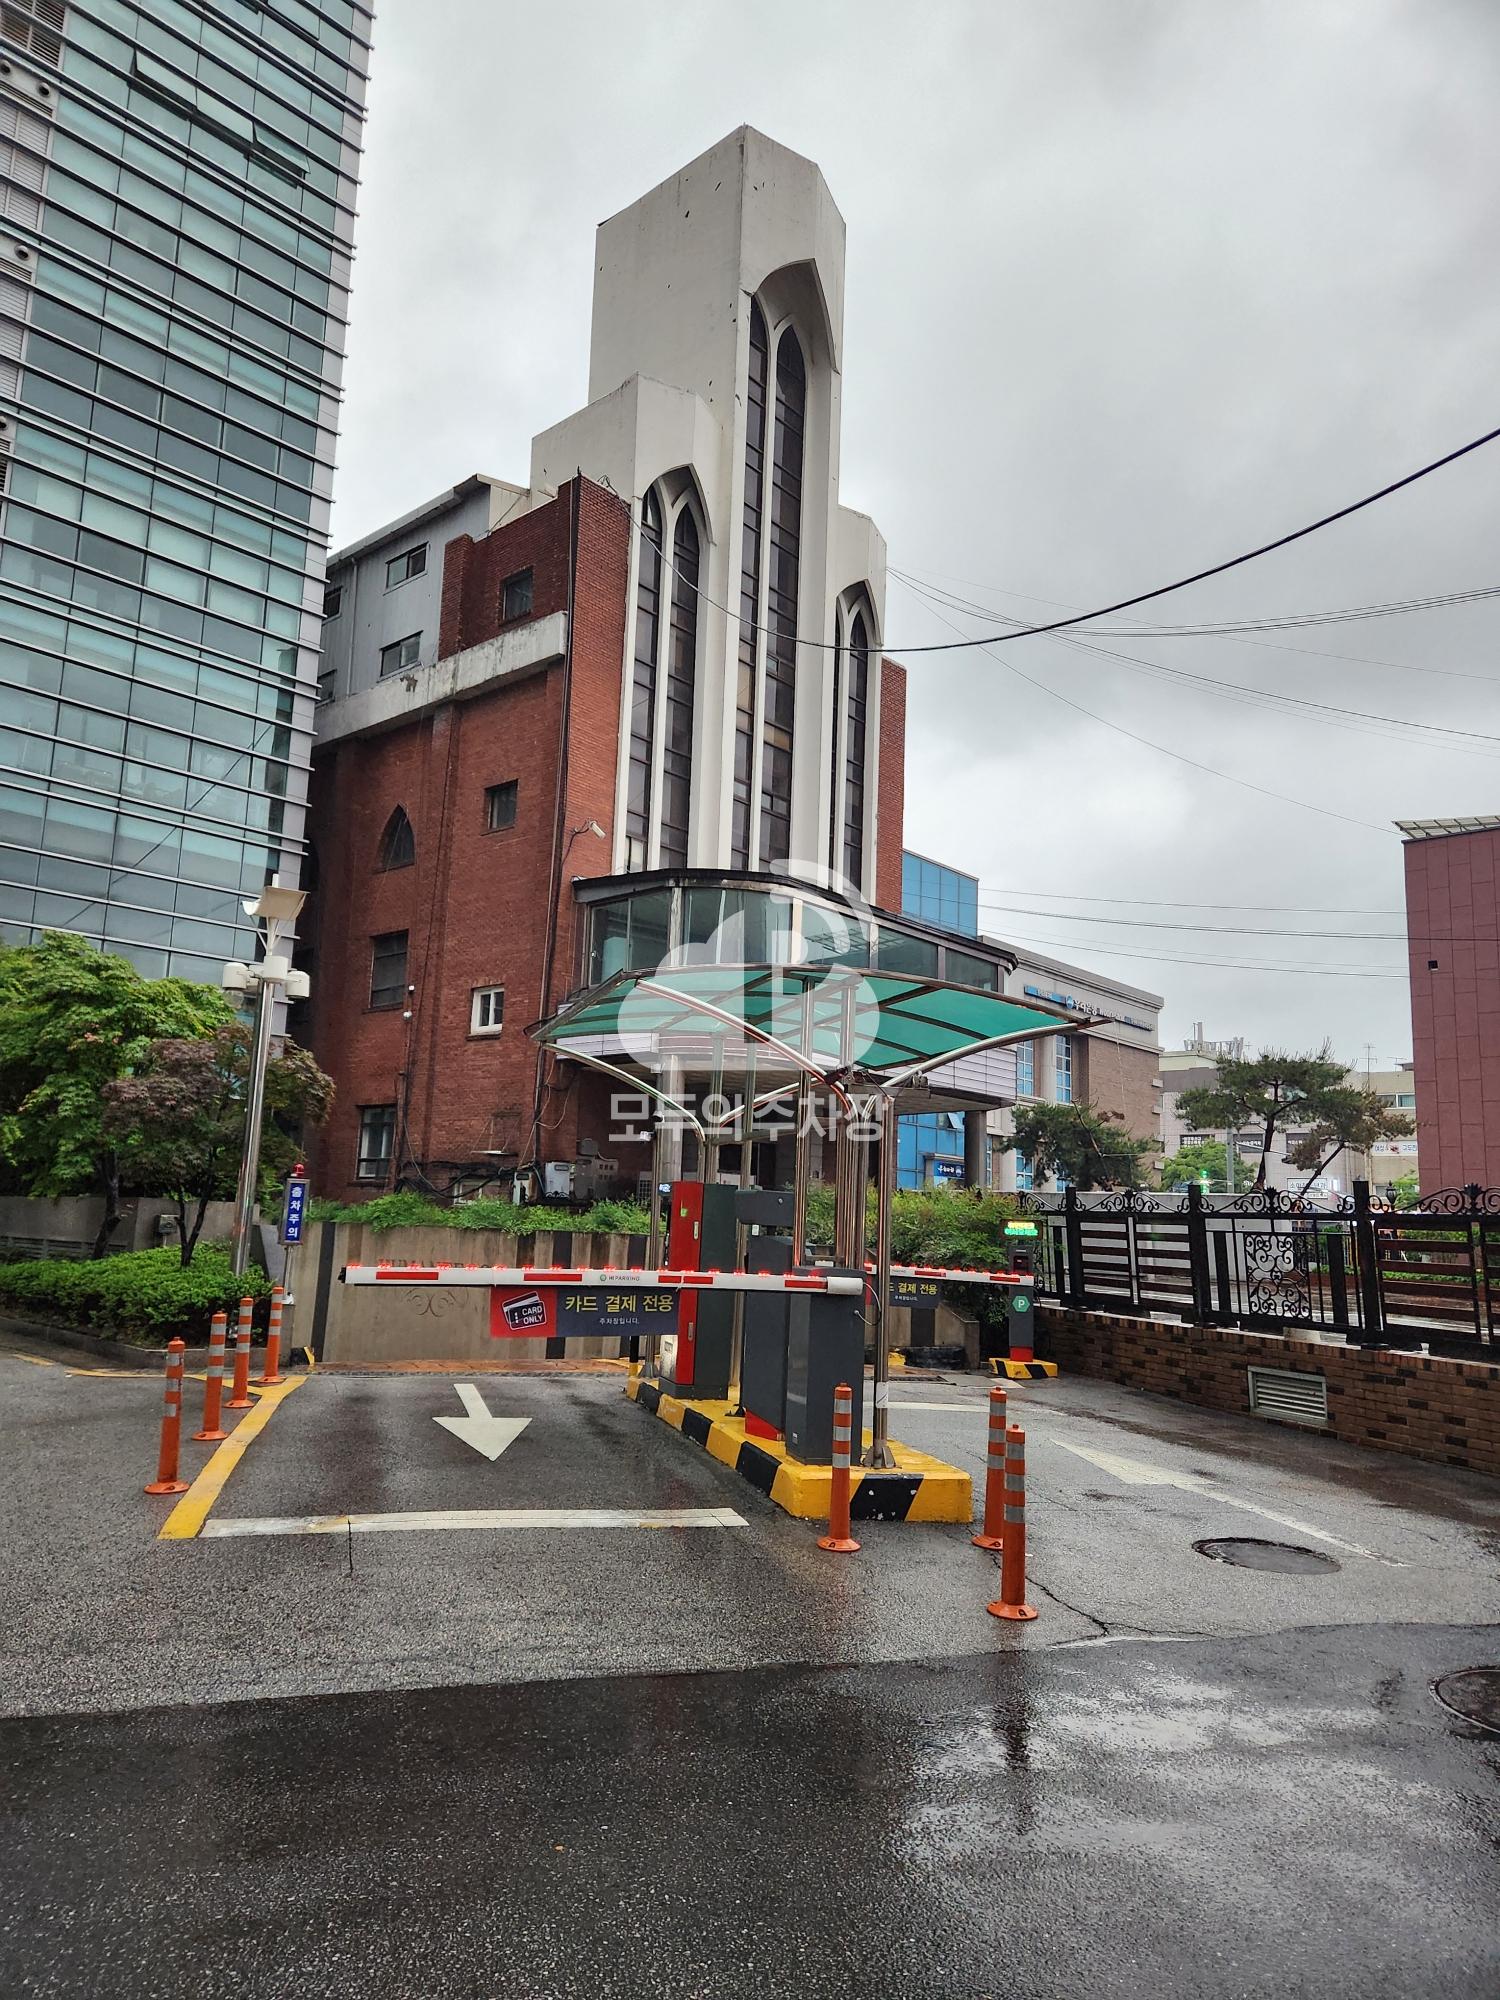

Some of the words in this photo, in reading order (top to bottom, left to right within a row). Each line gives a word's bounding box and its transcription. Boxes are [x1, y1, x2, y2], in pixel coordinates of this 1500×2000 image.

[287, 1186, 302, 1238] 출차주의
[898, 1282, 917, 1294] 결제
[920, 1283, 938, 1295] 전용
[565, 1294, 598, 1313] 카드
[605, 1294, 637, 1313] 결제
[642, 1294, 674, 1313] 전용
[521, 1305, 543, 1316] CARD
[523, 1314, 544, 1325] ONLY
